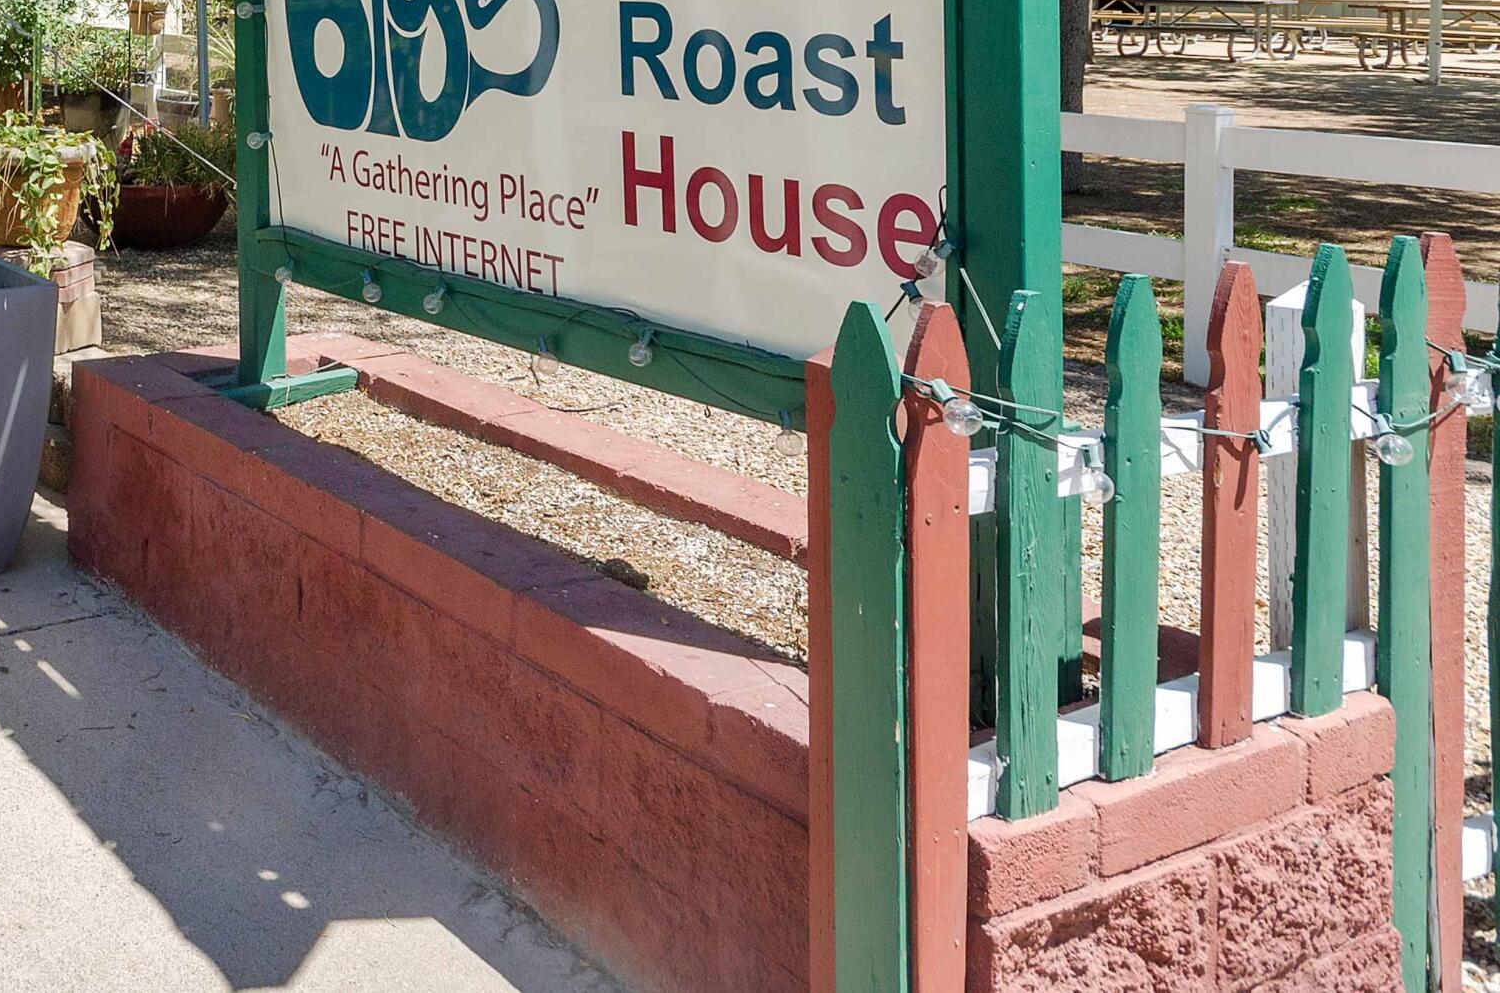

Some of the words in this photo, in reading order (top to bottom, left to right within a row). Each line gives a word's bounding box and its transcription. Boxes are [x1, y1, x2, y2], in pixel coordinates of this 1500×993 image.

[619, 0, 905, 126] Roast
[353, 150, 489, 222] Gathering
[622, 131, 943, 281] House
[347, 210, 406, 259] FREE
[415, 225, 564, 297] INTERNET
